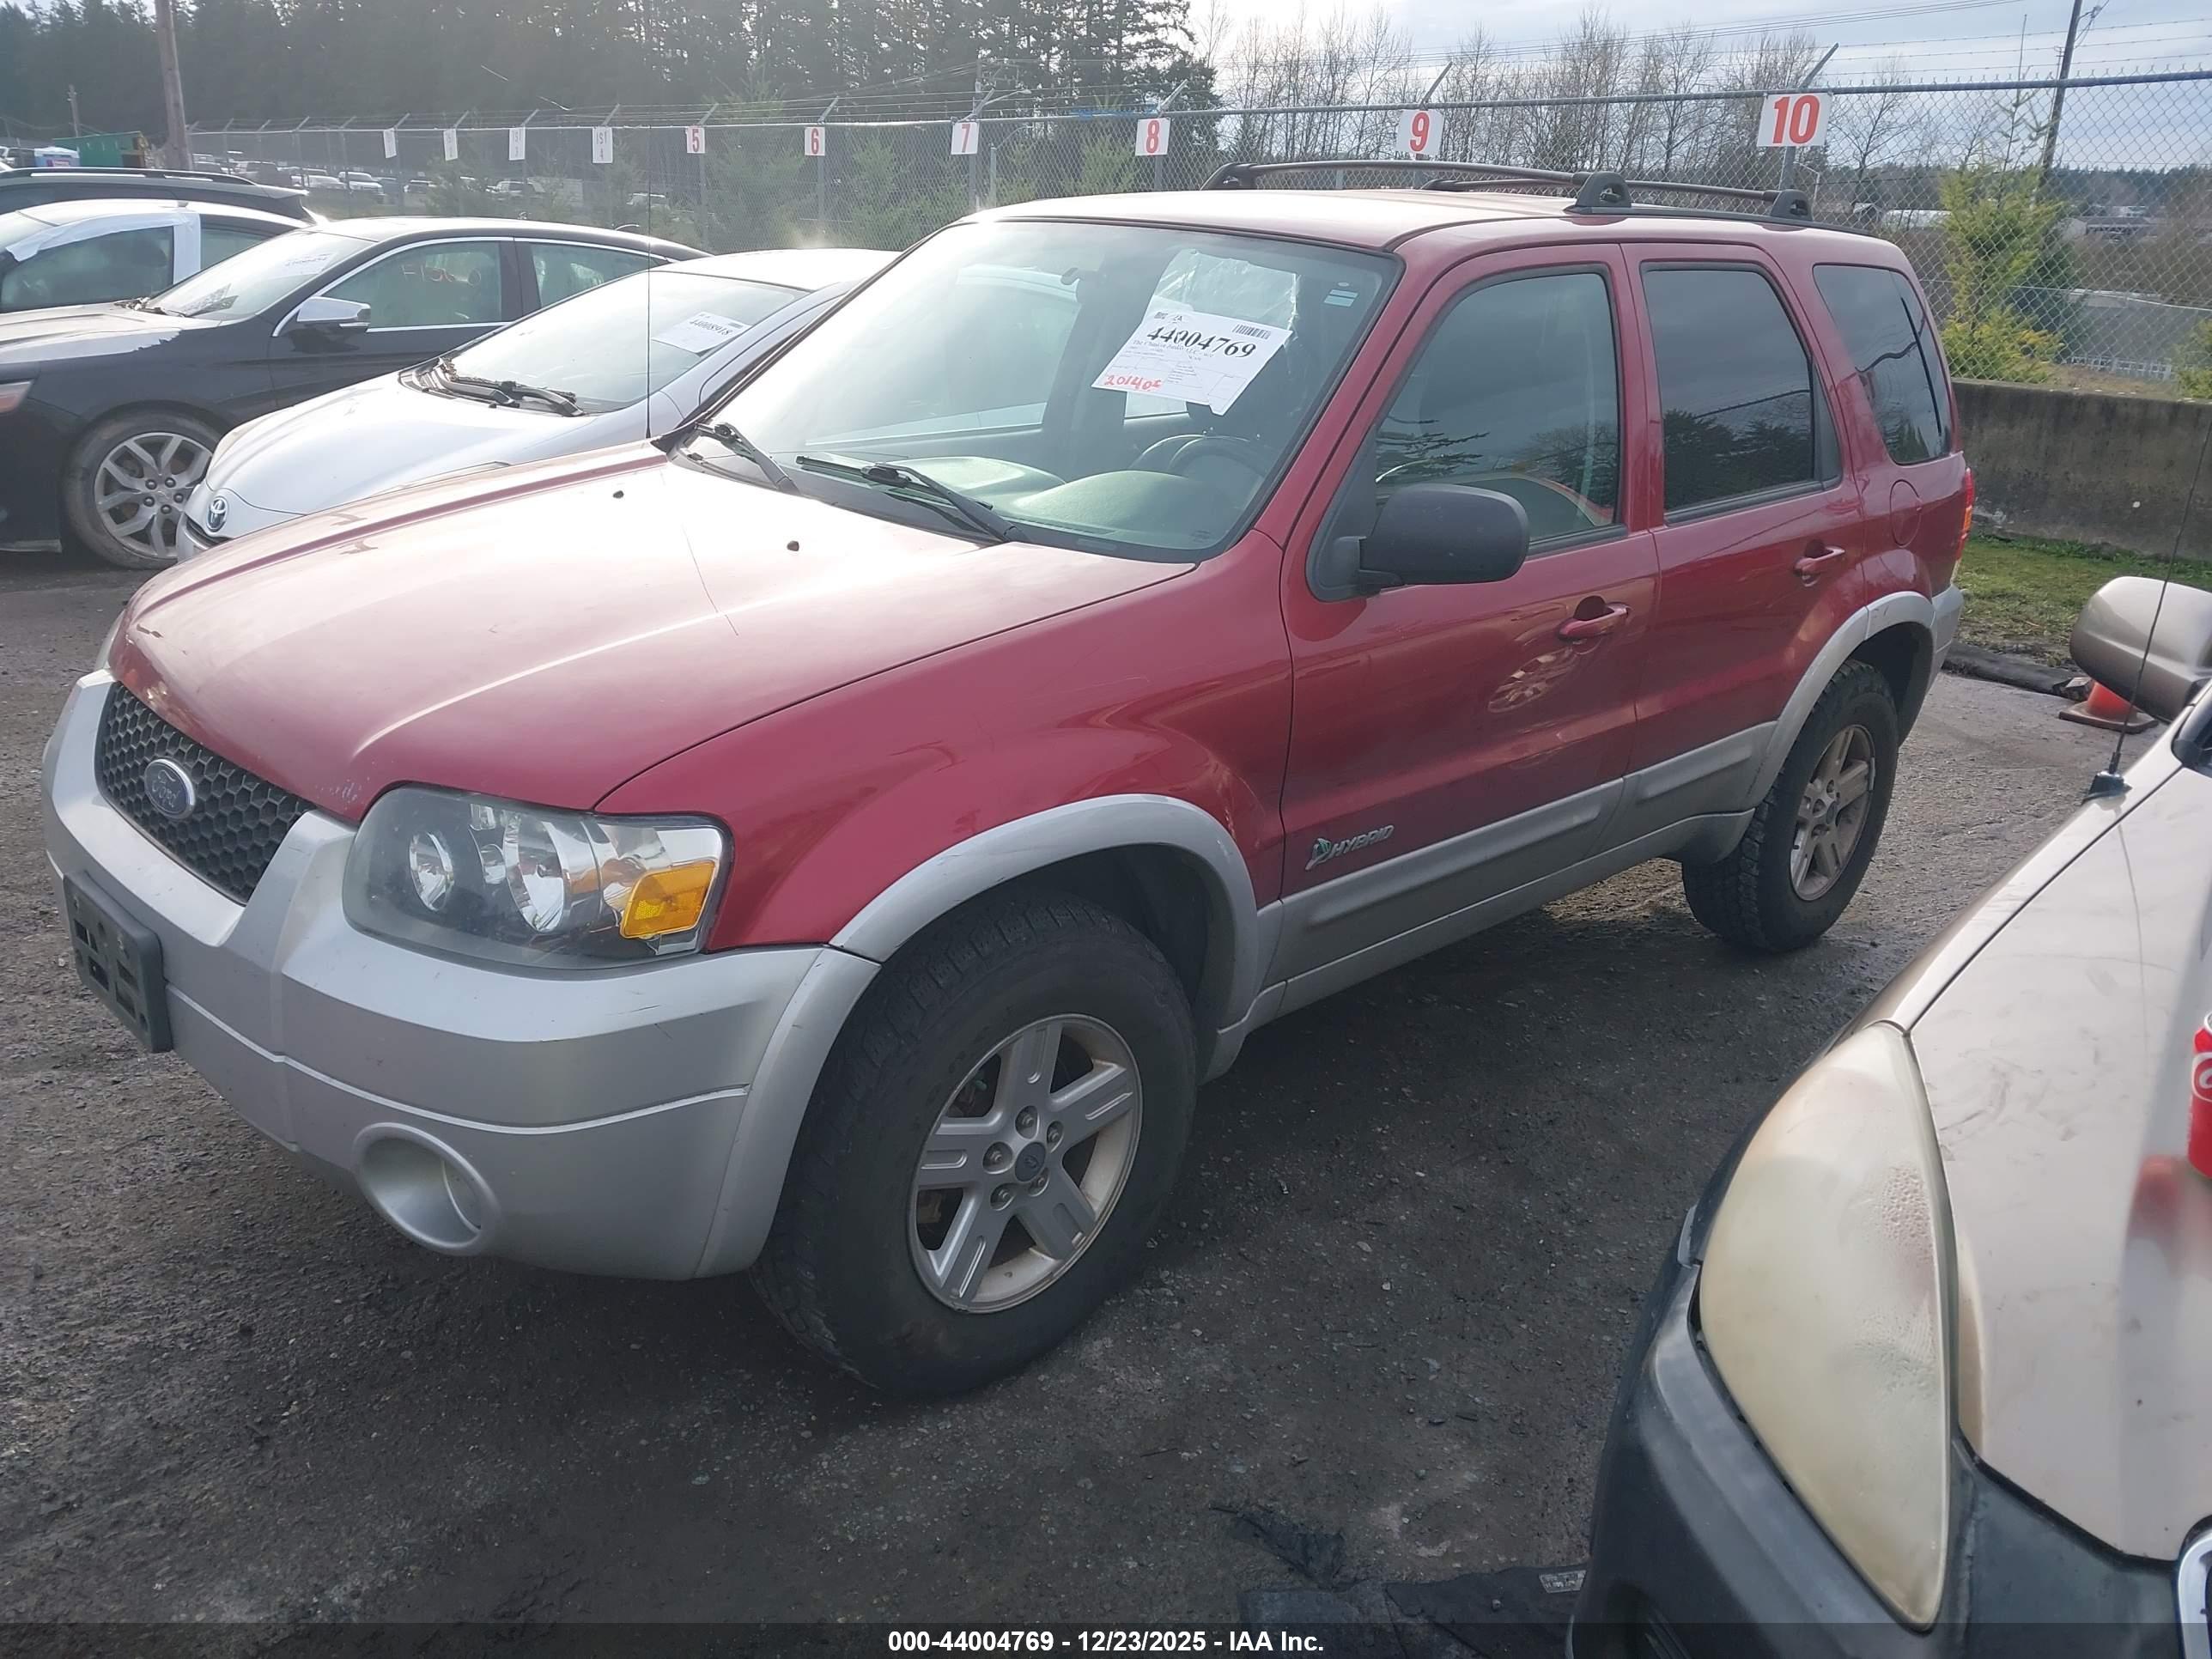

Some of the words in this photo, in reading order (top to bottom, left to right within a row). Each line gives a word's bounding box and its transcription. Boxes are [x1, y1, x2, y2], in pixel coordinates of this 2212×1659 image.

[1146, 119, 1160, 154] 8
[1409, 112, 1430, 152] 9
[1772, 94, 1820, 144] 10
[690, 128, 702, 153] 5
[810, 128, 820, 155] 6
[960, 124, 971, 154] 7
[1146, 325, 1257, 358] 44004769
[151, 769, 181, 808] Ford
[1328, 824, 1395, 860] HYBRID
